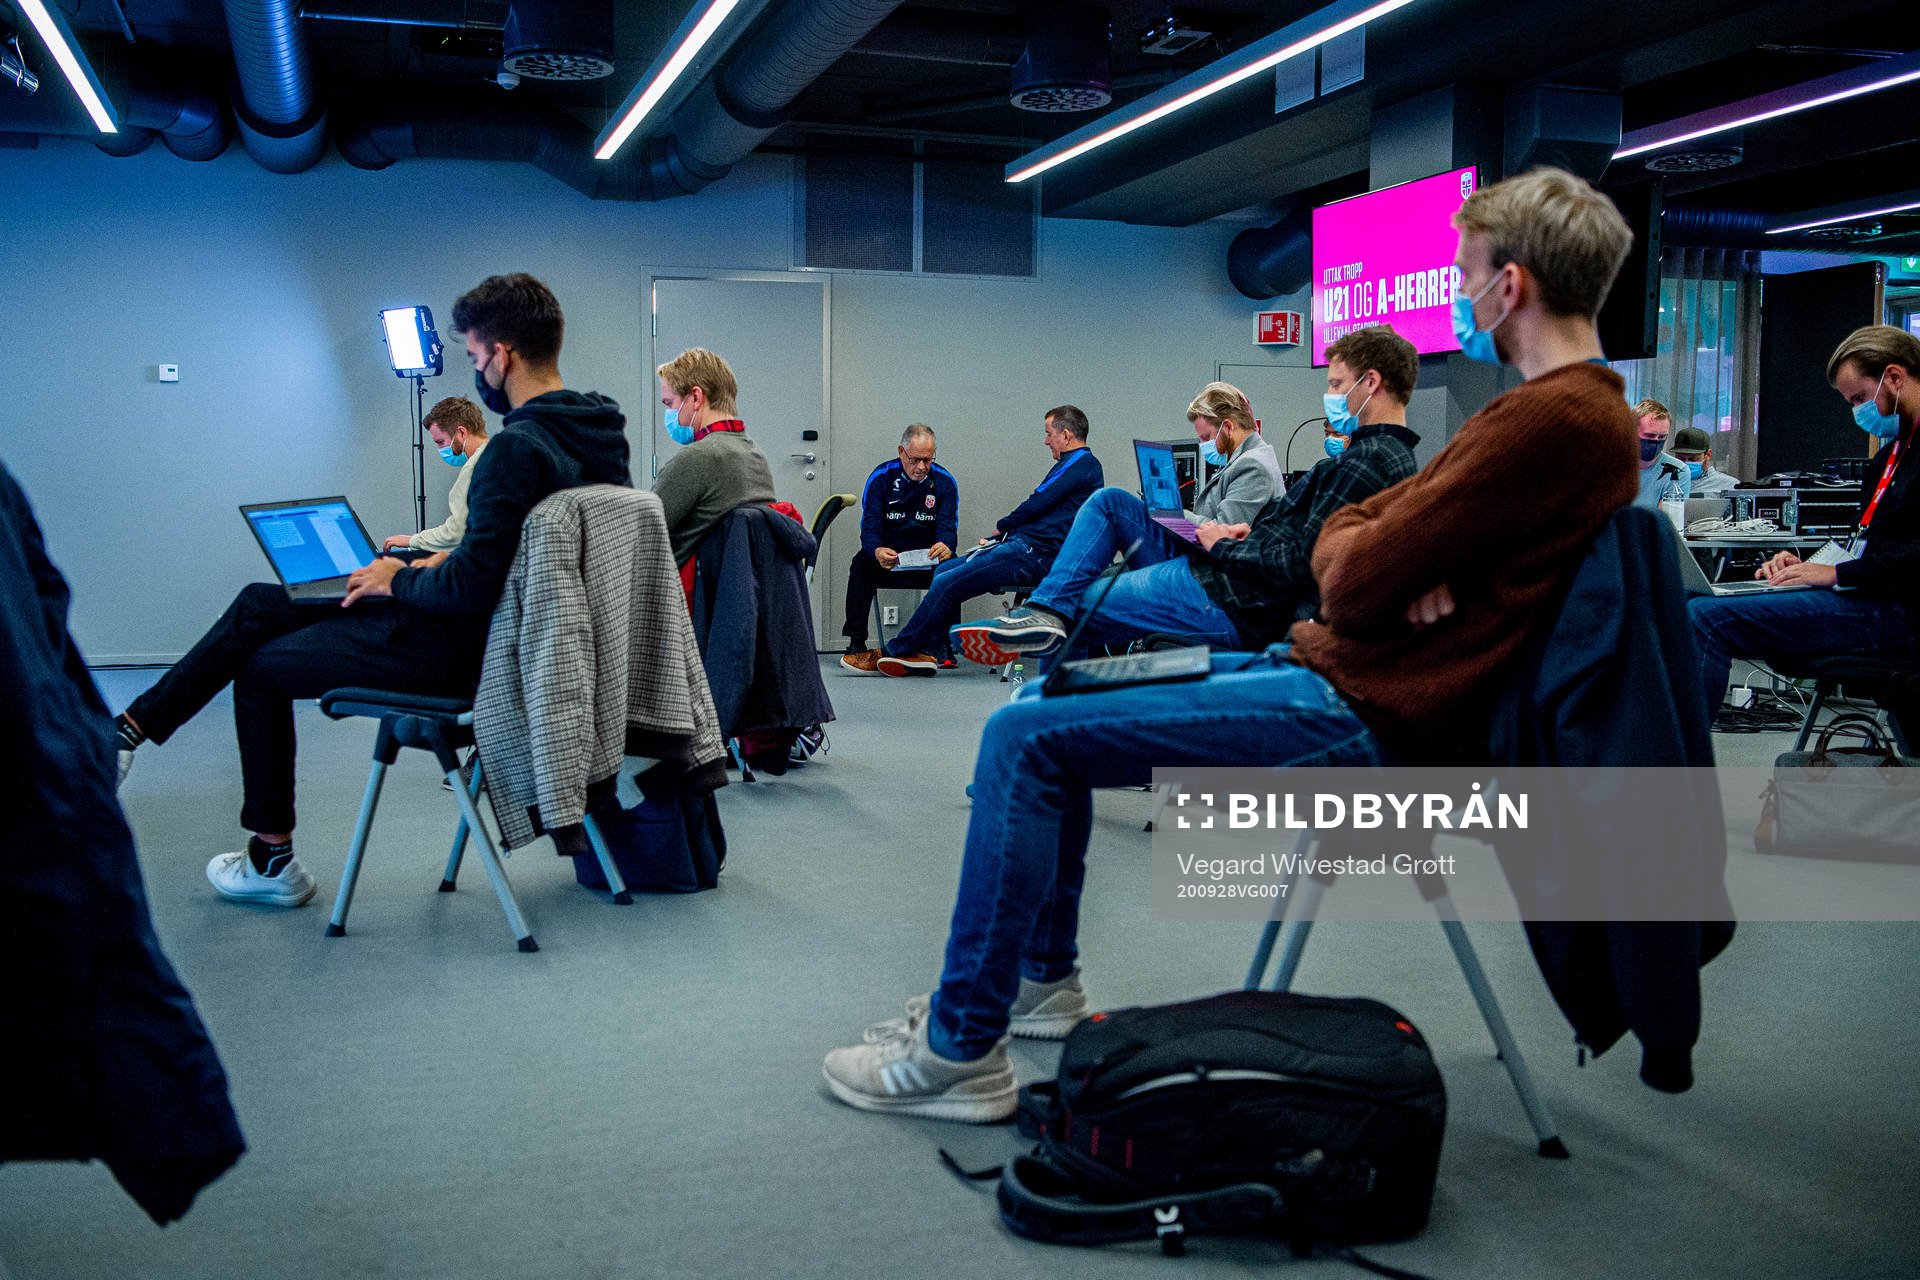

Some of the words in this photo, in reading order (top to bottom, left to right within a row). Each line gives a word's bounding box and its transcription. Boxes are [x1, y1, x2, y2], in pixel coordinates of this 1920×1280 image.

[1324, 266, 1342, 284] UTTAK
[1343, 261, 1362, 280] TROPP
[1324, 284, 1350, 323] U21
[1354, 281, 1373, 318] OG
